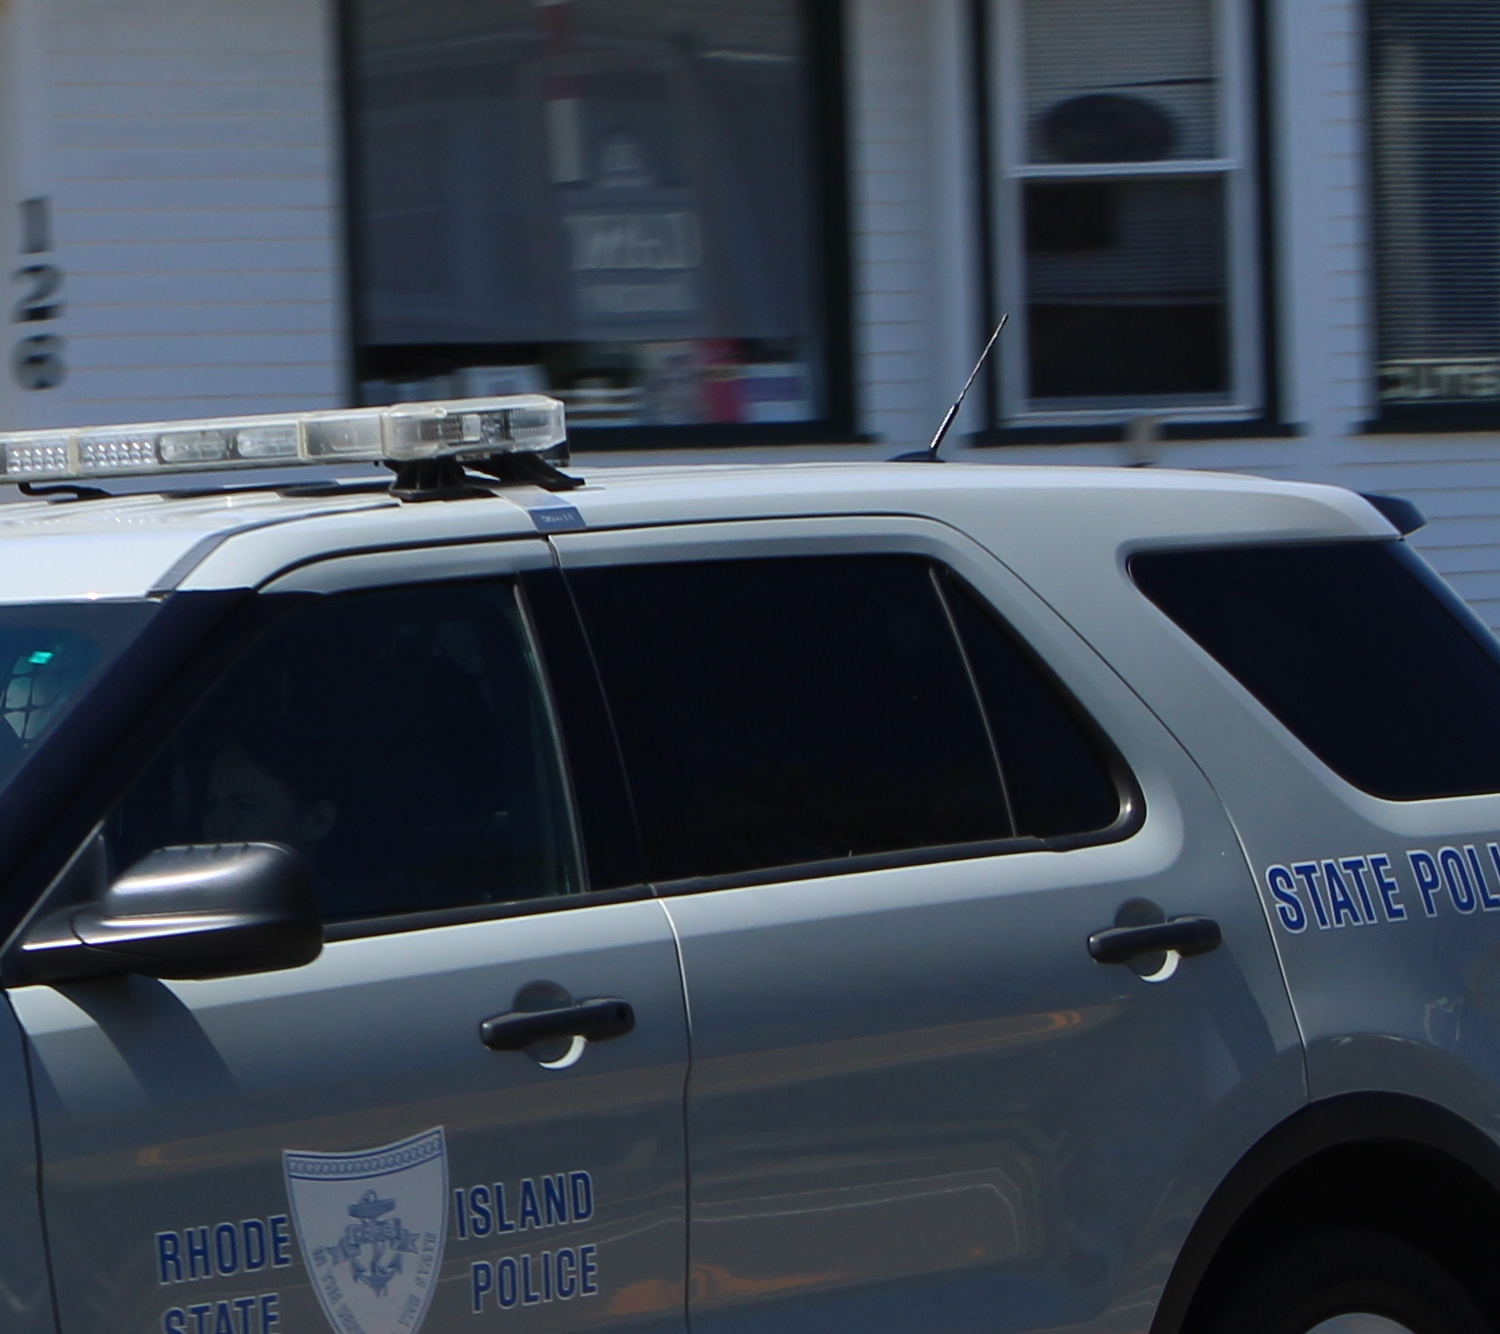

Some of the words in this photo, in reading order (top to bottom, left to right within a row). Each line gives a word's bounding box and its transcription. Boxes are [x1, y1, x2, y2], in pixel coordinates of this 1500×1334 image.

[10, 194, 67, 391] 126
[1266, 853, 1408, 934] STATE
[154, 1215, 294, 1285] RHODE
[453, 1170, 595, 1240] ISLAND
[471, 1244, 599, 1314] POLICE
